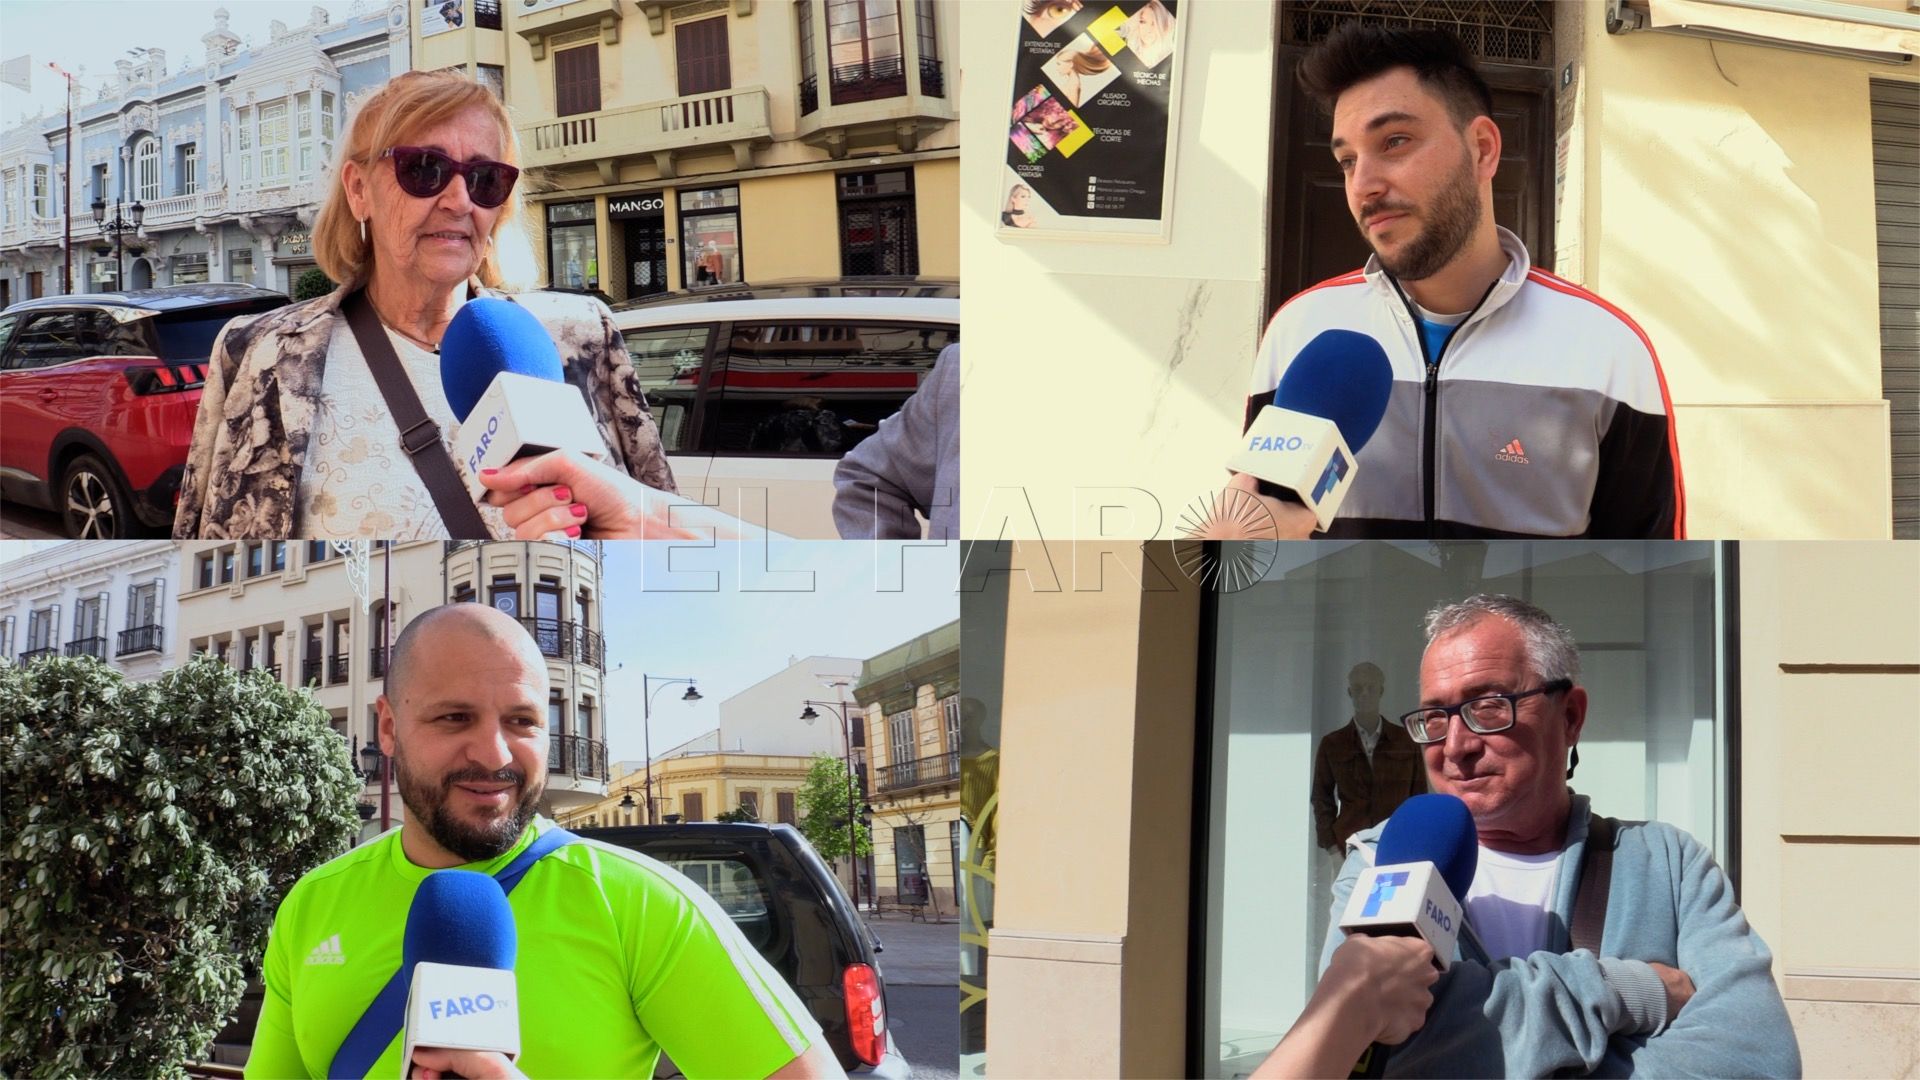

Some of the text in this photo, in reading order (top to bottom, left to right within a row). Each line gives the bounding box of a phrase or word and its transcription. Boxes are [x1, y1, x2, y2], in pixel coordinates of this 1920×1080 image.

[1564, 68, 1570, 84] 6
[1017, 164, 1044, 172] COLORES
[609, 198, 664, 213] MANGO
[469, 416, 498, 474] FARO
[1248, 436, 1302, 451] FARO
[1495, 453, 1529, 464] adidas
[1425, 898, 1452, 932] FARO
[429, 993, 495, 1019] FARO
